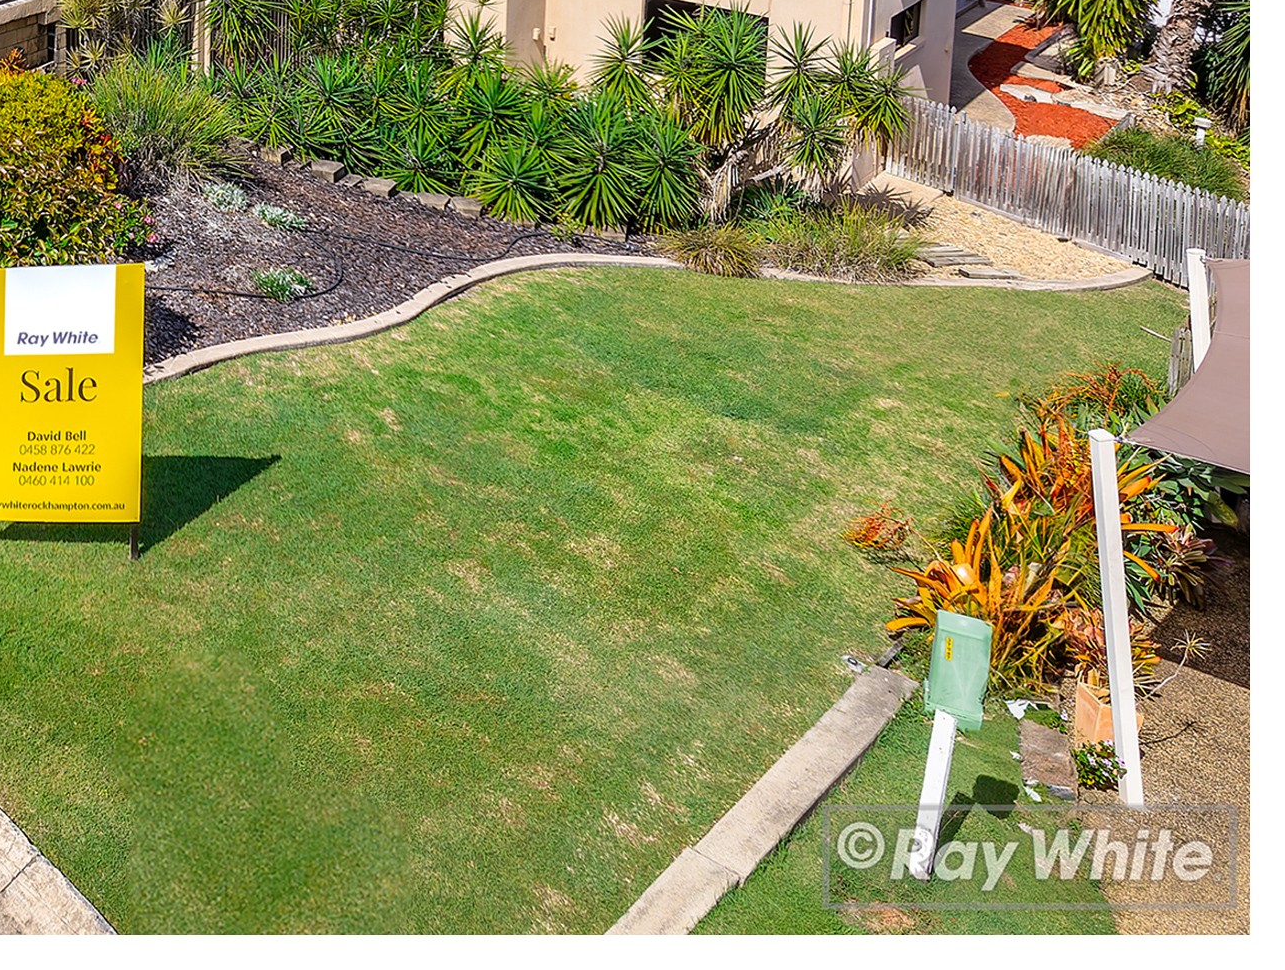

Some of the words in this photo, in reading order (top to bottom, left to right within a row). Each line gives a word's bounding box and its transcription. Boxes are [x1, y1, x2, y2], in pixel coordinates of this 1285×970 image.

[17, 332, 49, 347] Ray
[53, 331, 99, 344] White
[20, 367, 98, 403] Sale
[27, 430, 61, 441] David
[65, 430, 86, 441] Bell
[19, 444, 47, 455] 0458
[50, 444, 72, 455] 876
[74, 444, 95, 455] 422
[12, 462, 58, 472] Nadene
[62, 461, 101, 472] Lawrie
[18, 475, 46, 486] 0460
[50, 475, 70, 486] 414
[75, 475, 95, 486] 100
